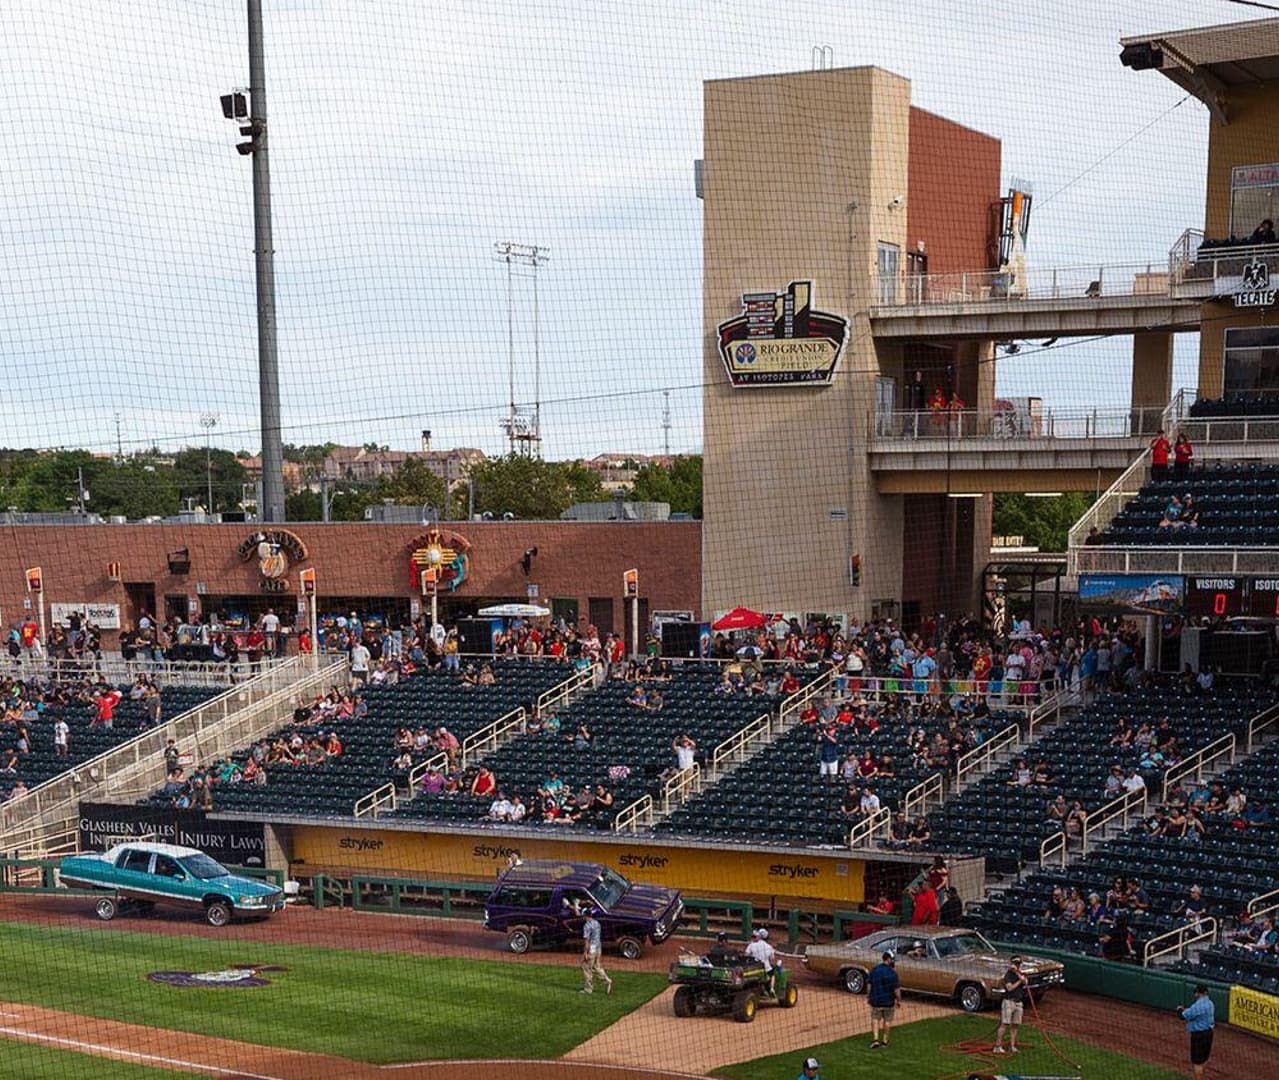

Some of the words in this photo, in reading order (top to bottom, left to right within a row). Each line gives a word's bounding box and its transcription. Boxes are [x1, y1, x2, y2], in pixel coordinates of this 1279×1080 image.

[781, 343, 828, 354] GRANDE
[1196, 579, 1235, 590] VISITORS
[1214, 593, 1227, 614] 0
[139, 821, 175, 837] VALLES
[180, 831, 226, 848] INJURY
[230, 834, 265, 851] LAWY
[339, 836, 384, 851] stryker
[619, 853, 669, 868] stryker
[768, 863, 819, 879] stryker
[1235, 997, 1279, 1022] AMERICAN
